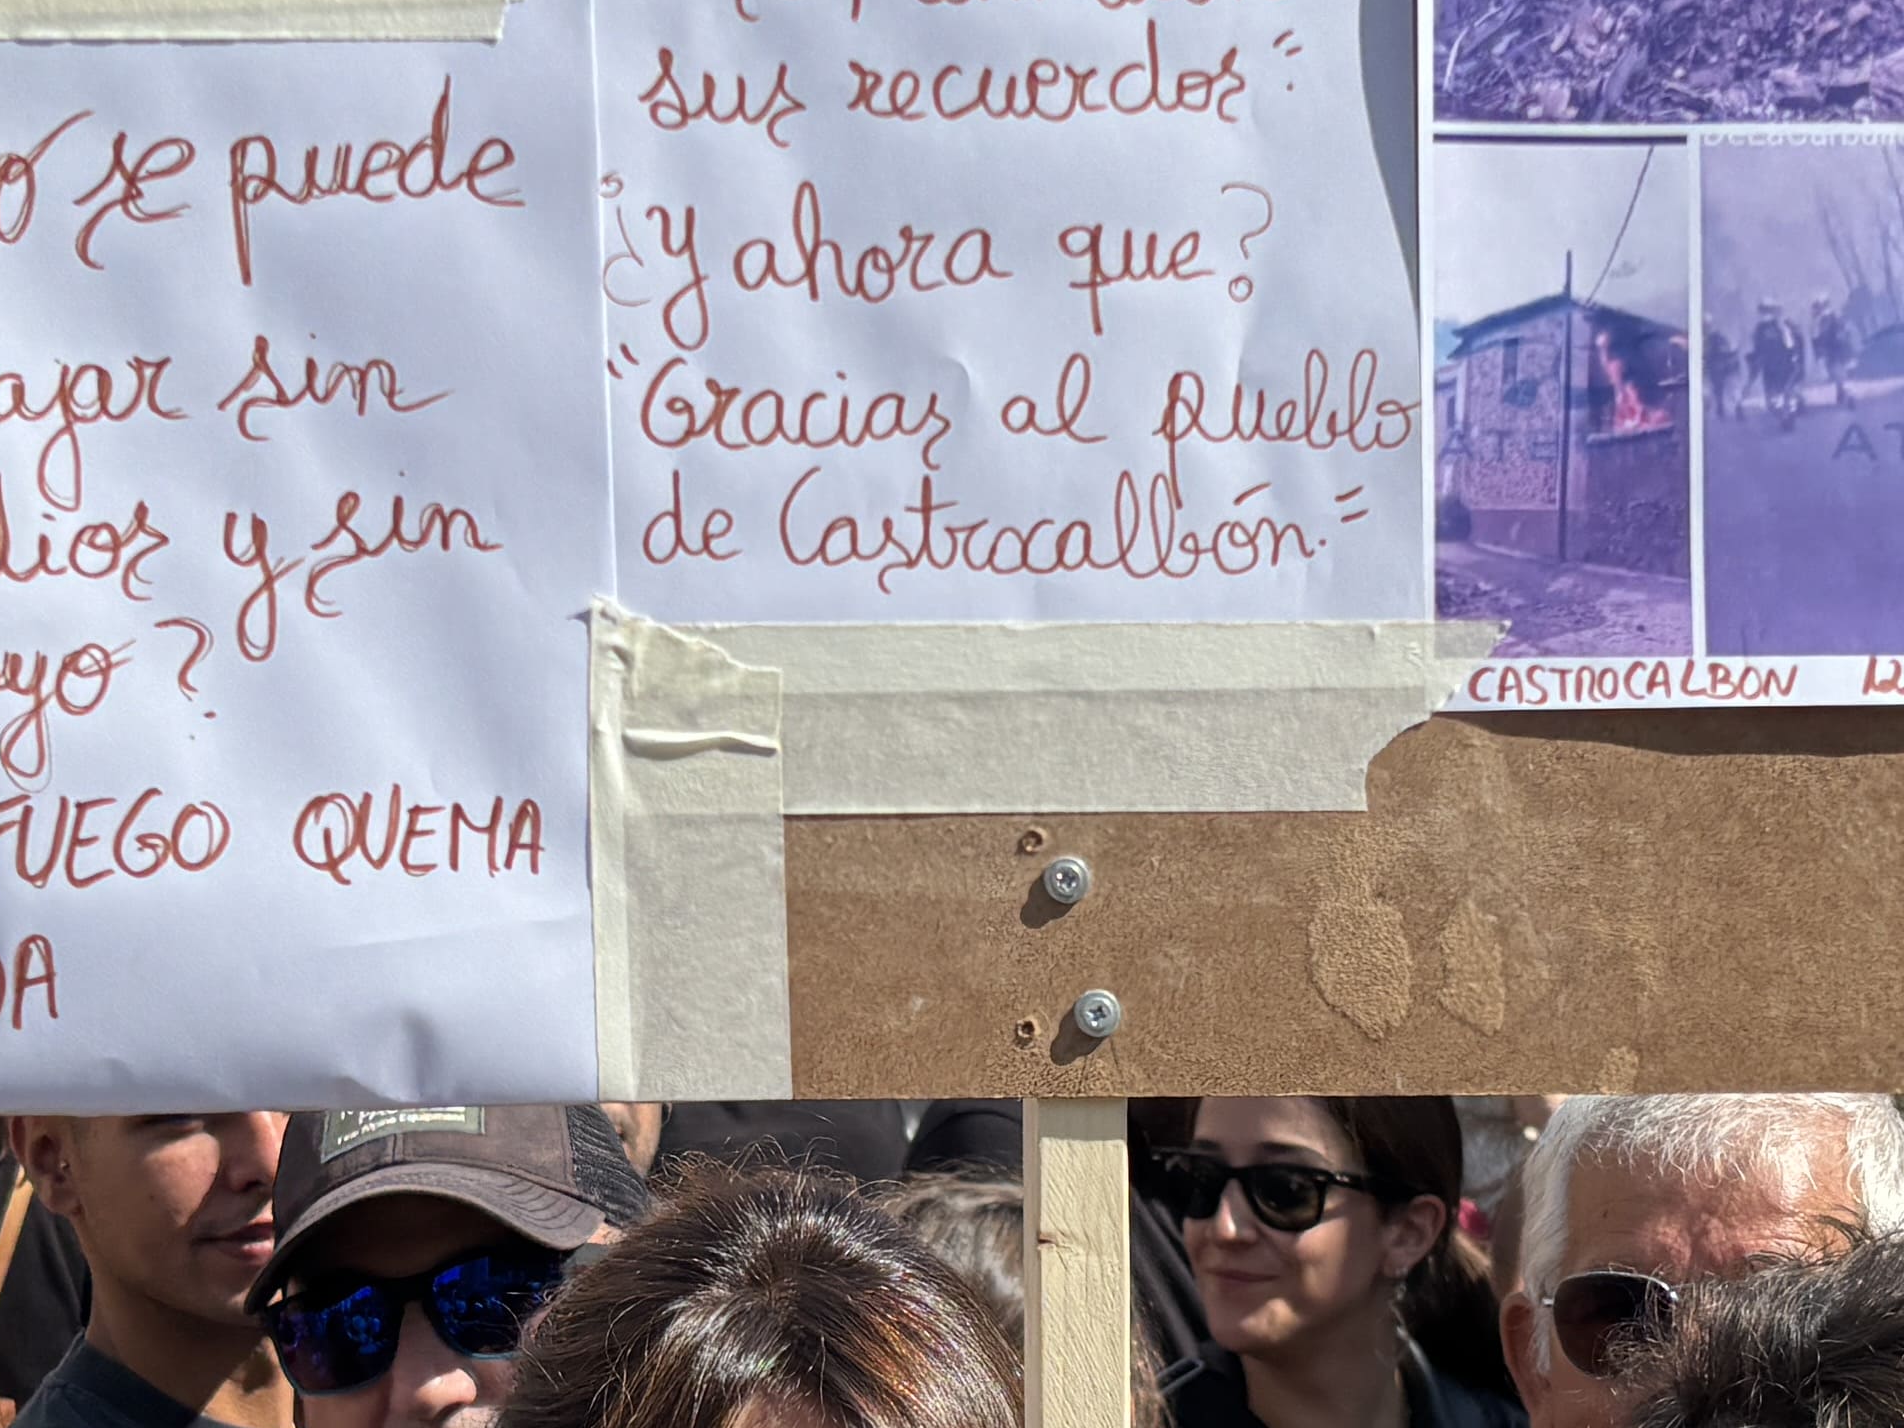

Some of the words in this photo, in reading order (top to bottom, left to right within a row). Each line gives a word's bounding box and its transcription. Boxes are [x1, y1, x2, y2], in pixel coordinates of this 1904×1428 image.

[639, 45, 807, 150] sus
[73, 131, 196, 271] se
[229, 76, 525, 287] puede
[732, 180, 1013, 304] ahora
[1058, 184, 1273, 337] que?
[217, 333, 447, 443] sin
[1001, 352, 1108, 444] al
[642, 469, 740, 566] de
[223, 511, 304, 664] y
[304, 491, 502, 619] sin
[1468, 660, 1798, 705] CASTROCALBON
[292, 782, 544, 887] QUEMA
